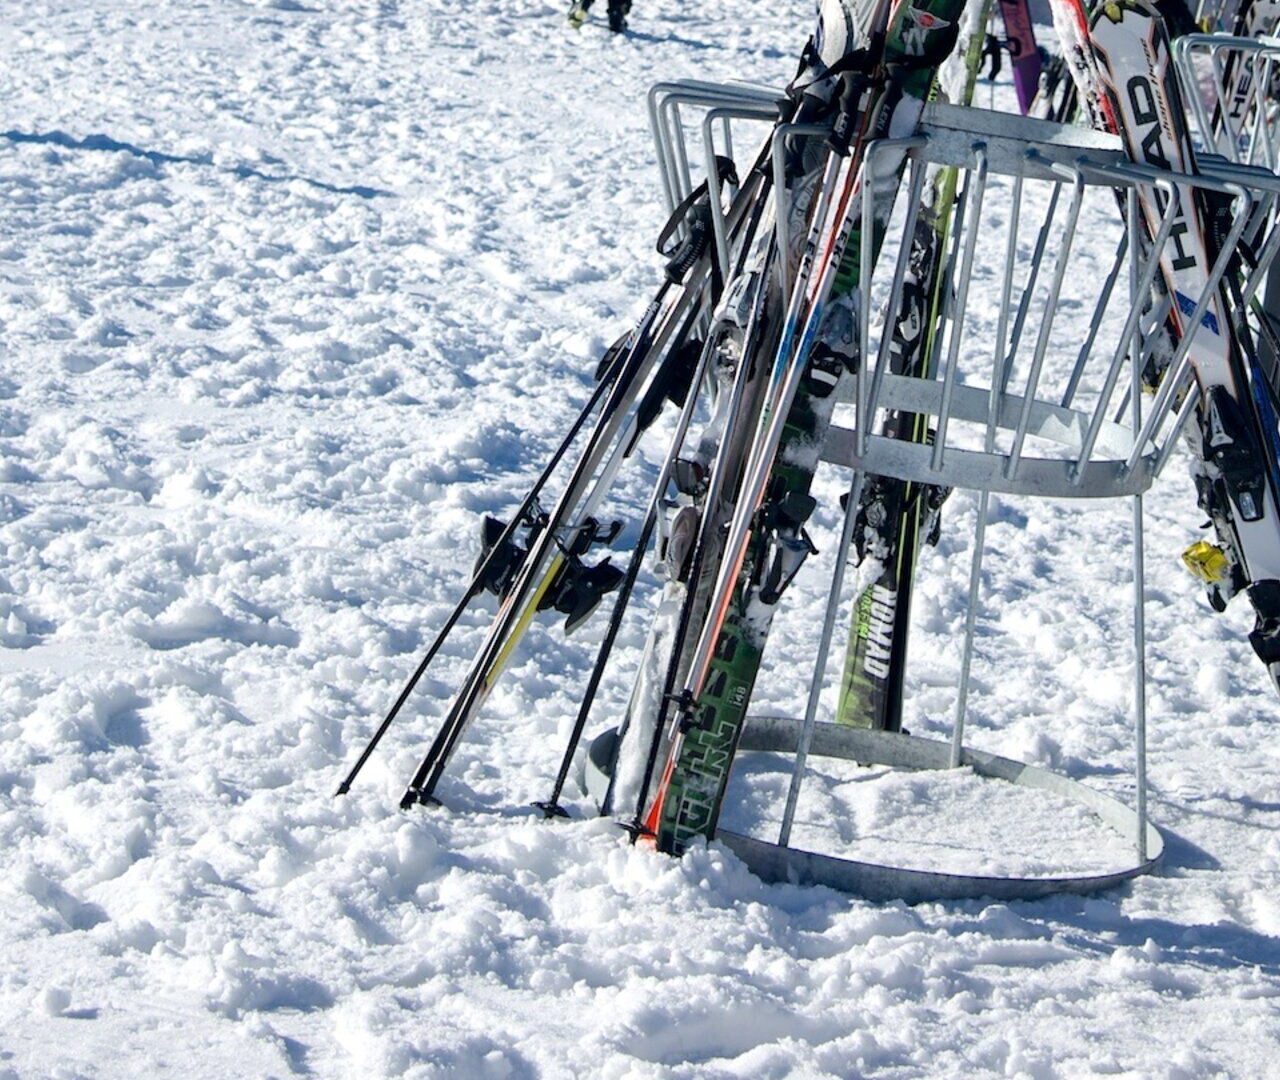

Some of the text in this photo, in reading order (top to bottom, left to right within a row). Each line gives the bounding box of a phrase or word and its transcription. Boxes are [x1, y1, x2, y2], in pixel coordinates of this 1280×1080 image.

[1126, 76, 1197, 271] HEAD
[863, 584, 898, 680] NOMAD
[733, 686, 747, 709] 148
